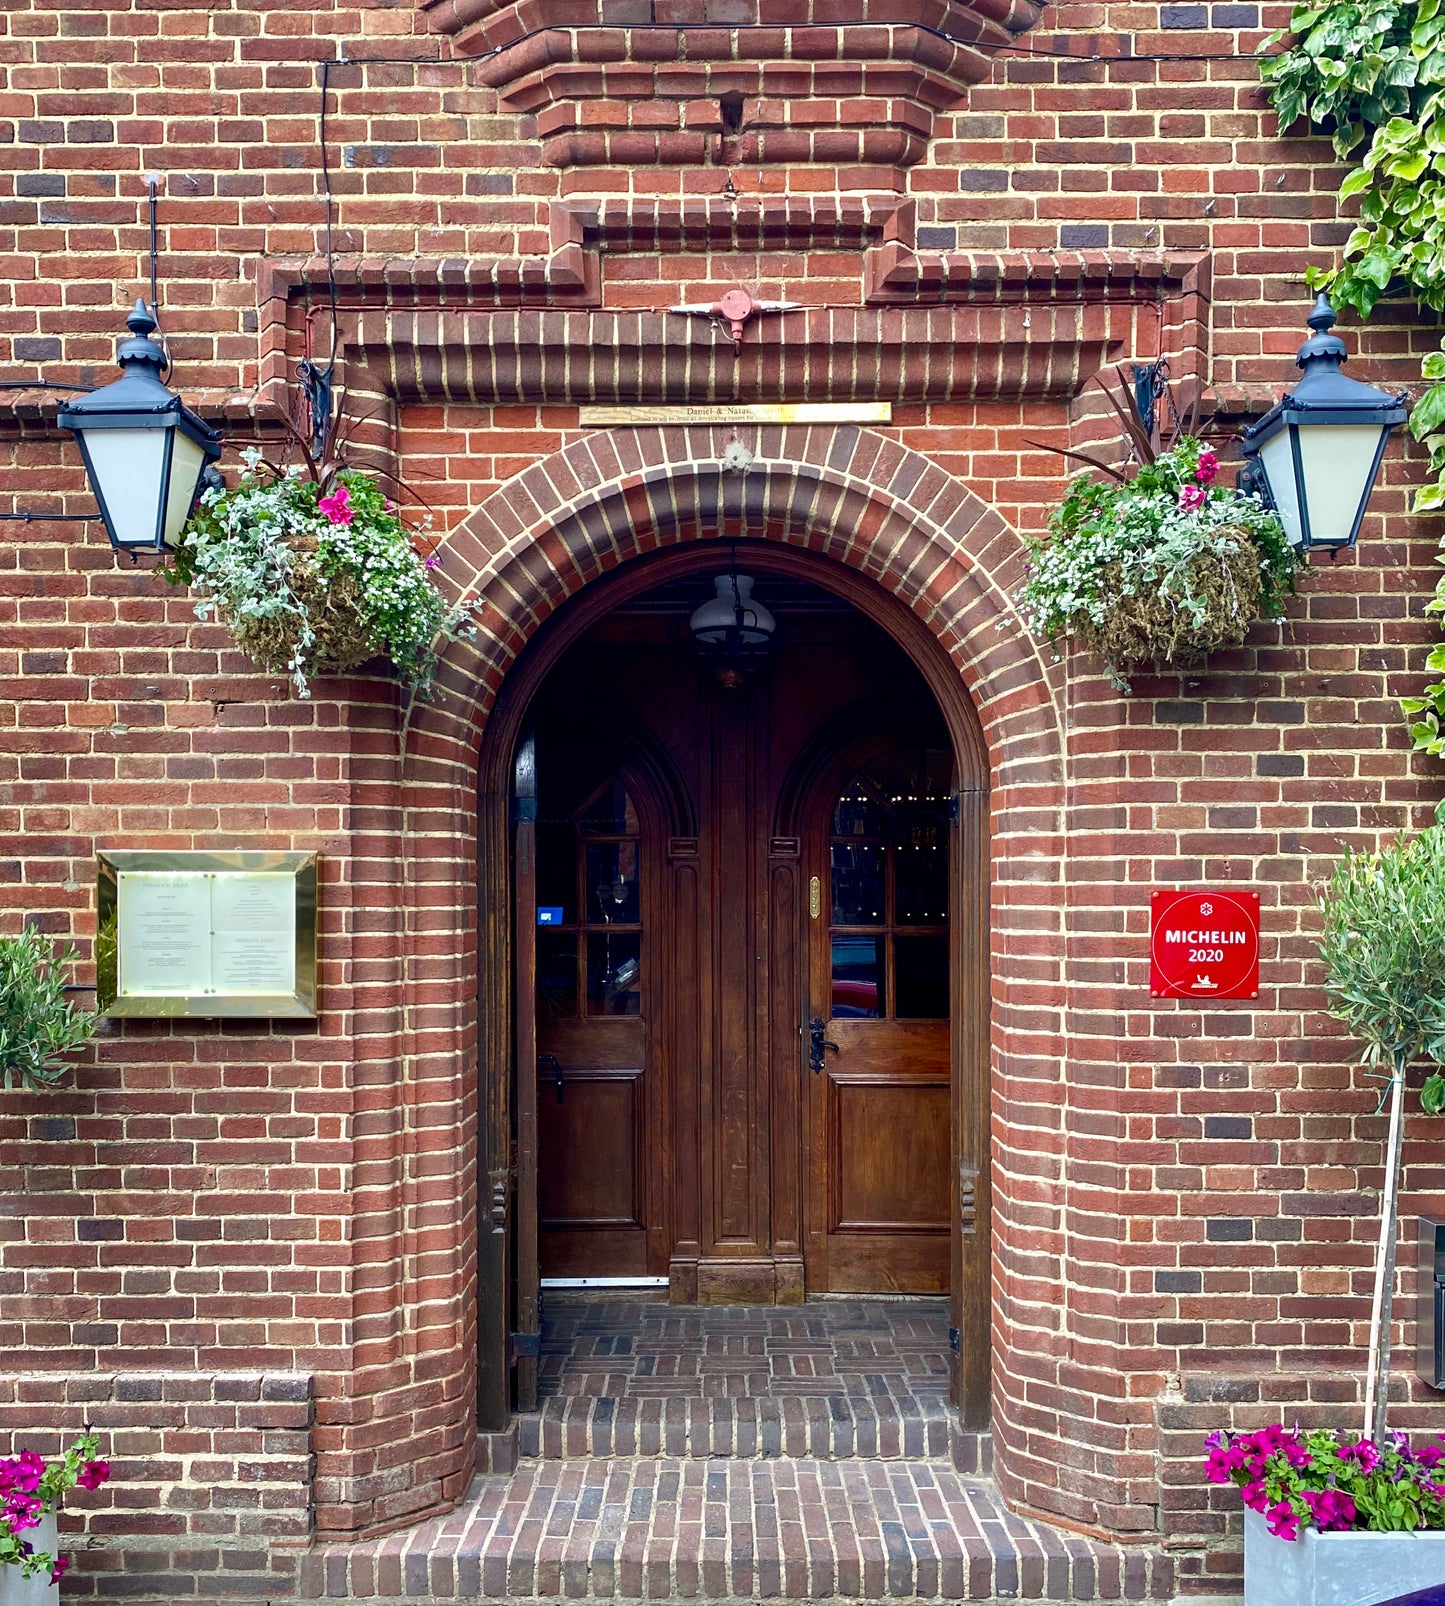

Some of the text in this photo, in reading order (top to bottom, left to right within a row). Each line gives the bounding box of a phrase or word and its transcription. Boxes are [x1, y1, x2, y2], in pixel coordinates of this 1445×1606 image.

[687, 407, 713, 415] Daniel
[716, 407, 722, 415] &
[1165, 930, 1246, 944] MICHELIN
[1188, 949, 1224, 962] 2020
